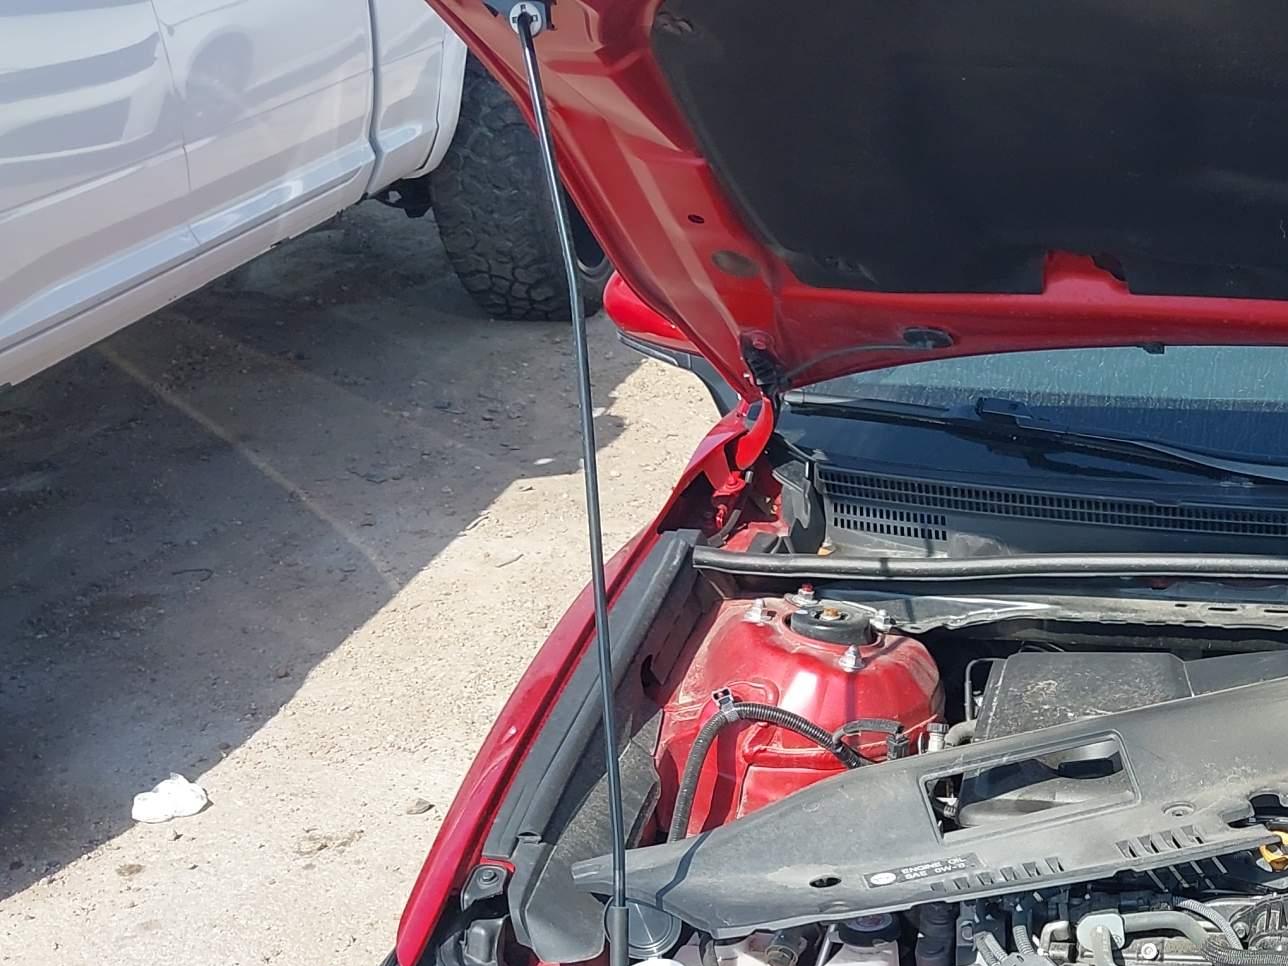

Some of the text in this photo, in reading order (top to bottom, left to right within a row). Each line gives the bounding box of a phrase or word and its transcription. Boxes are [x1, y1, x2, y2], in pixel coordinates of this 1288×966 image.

[901, 856, 967, 875] ENGINE OIL
[905, 870, 928, 880] SAE
